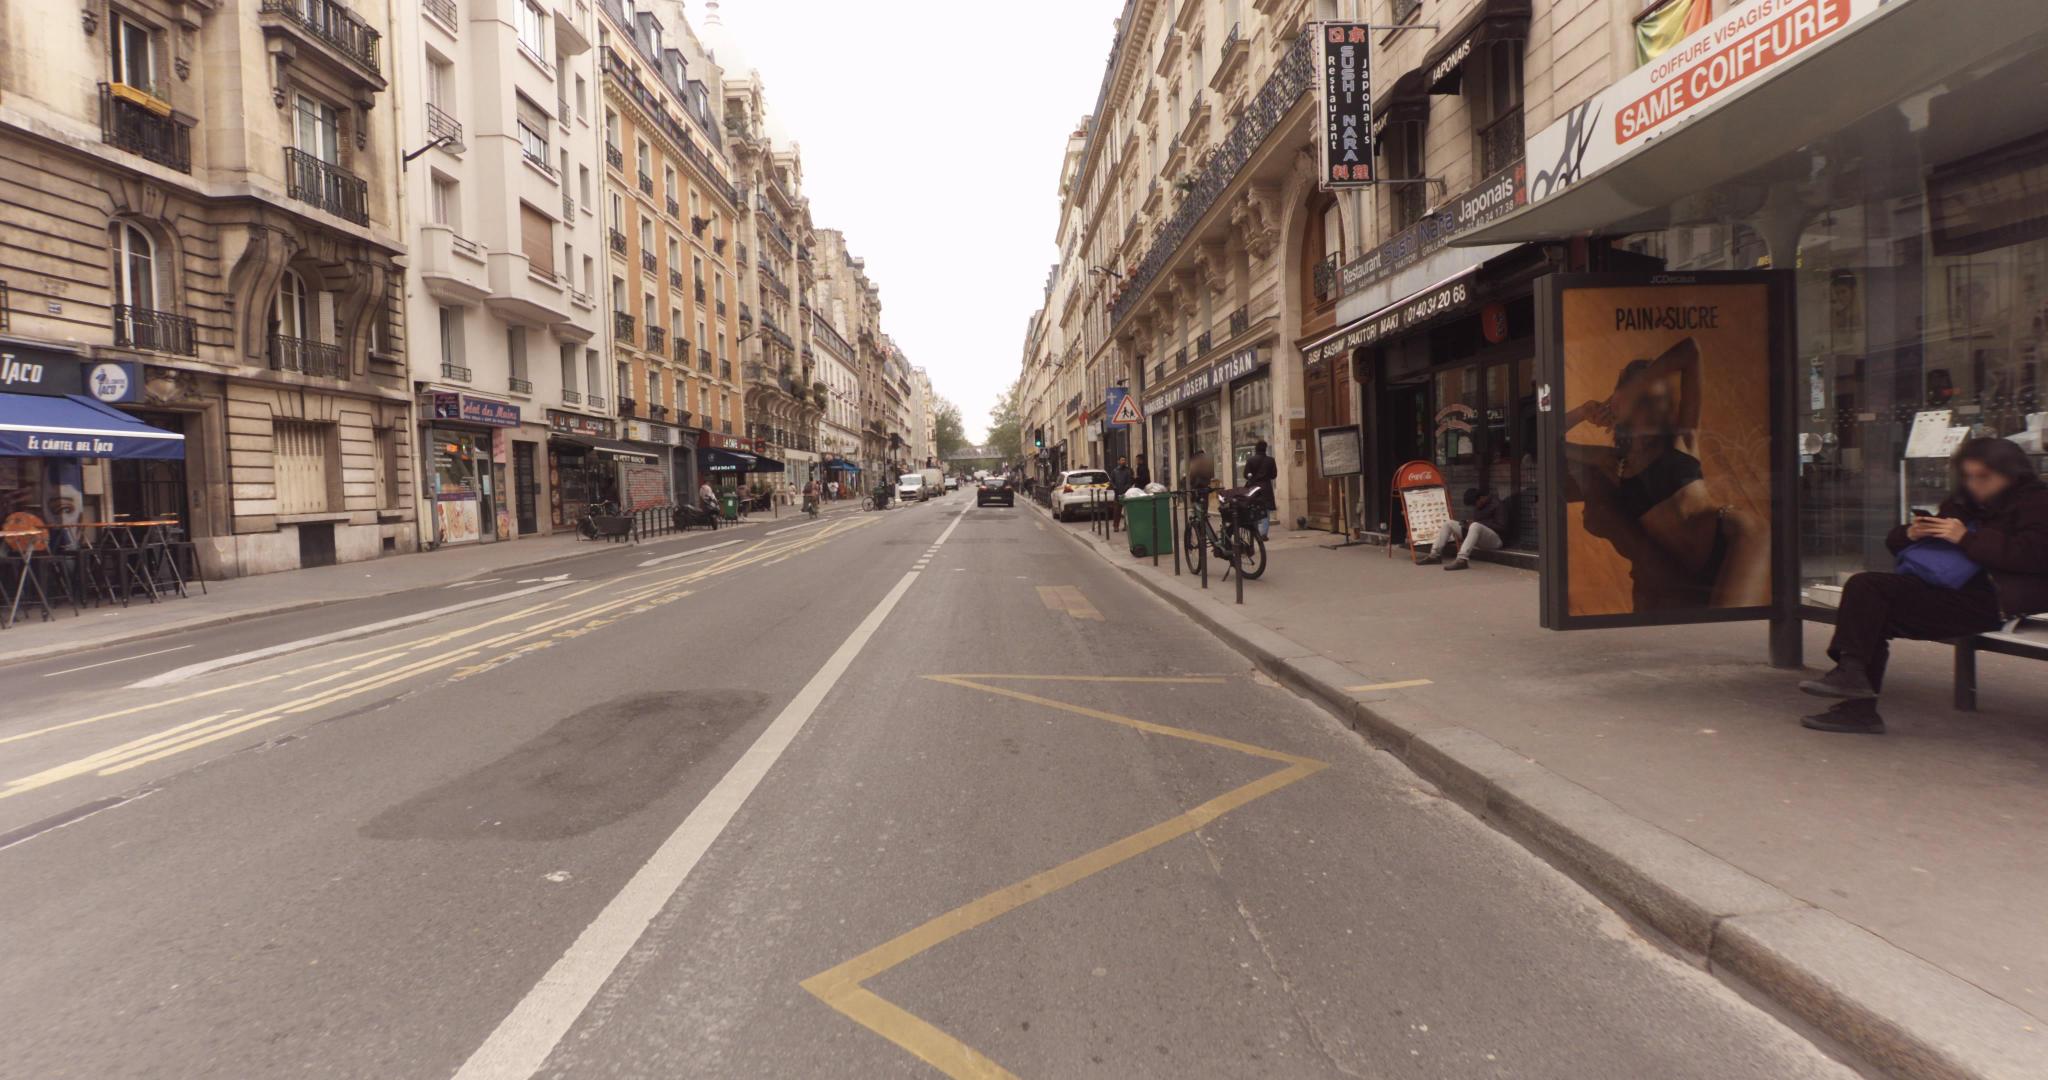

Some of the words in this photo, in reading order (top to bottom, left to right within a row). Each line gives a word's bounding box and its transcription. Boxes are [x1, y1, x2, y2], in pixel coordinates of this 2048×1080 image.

[1432, 39, 1471, 85] JAPONAIS
[1621, 78, 1685, 138] SAME
[1690, 0, 1839, 100] COIFFURE
[1650, 37, 1711, 83] COIFFURE
[1714, 0, 1791, 45] VISAGIS
[1328, 55, 1338, 150] Restaurant
[1340, 45, 1356, 104] SUSHI
[1362, 58, 1370, 145] Japonais
[1342, 114, 1359, 162] NARA
[1343, 250, 1381, 286] Restaurant
[1459, 176, 1514, 223] Japonais
[1347, 323, 1377, 347] YAKITORI
[1380, 312, 1399, 334] MAKI
[1438, 290, 1450, 309] 20
[1452, 283, 1466, 304] 68
[1615, 306, 1653, 331] PAIN
[1666, 305, 1719, 330] SUCRE
[1182, 373, 1209, 399] JOSEPH
[1212, 351, 1252, 386] ARTISAN
